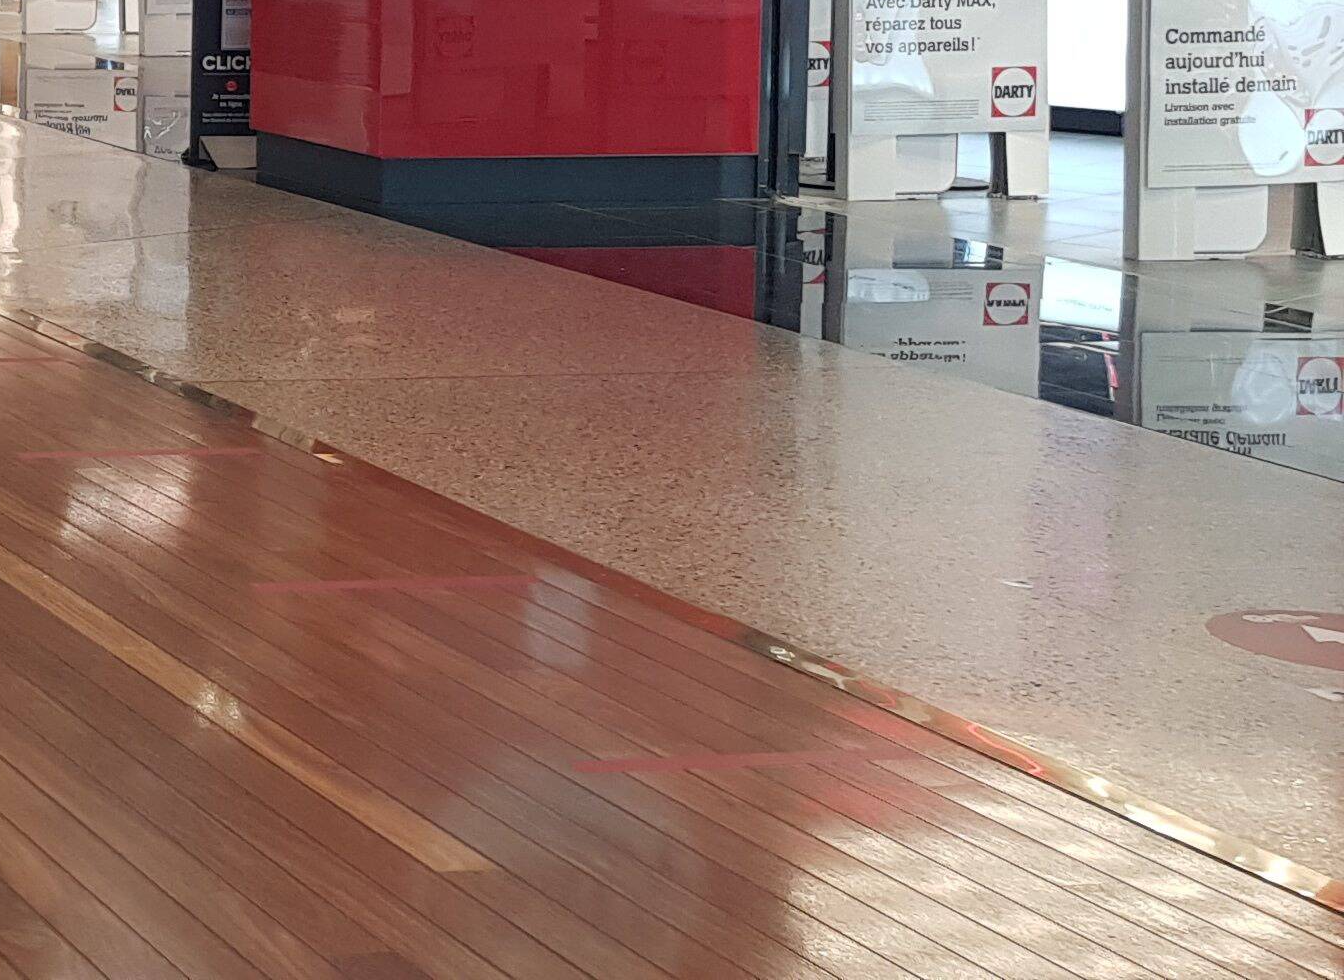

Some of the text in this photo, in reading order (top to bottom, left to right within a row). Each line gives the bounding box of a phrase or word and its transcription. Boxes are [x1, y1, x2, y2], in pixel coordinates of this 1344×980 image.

[866, 17, 962, 34] réparez tous
[1166, 26, 1265, 44] Commandé
[866, 42, 893, 53] vos
[807, 59, 829, 70] RTY
[1166, 51, 1265, 72] aujourd'hui
[994, 85, 1034, 98] DARTY
[1166, 75, 1297, 94] installé demain
[1164, 103, 1234, 112] Livraison avec
